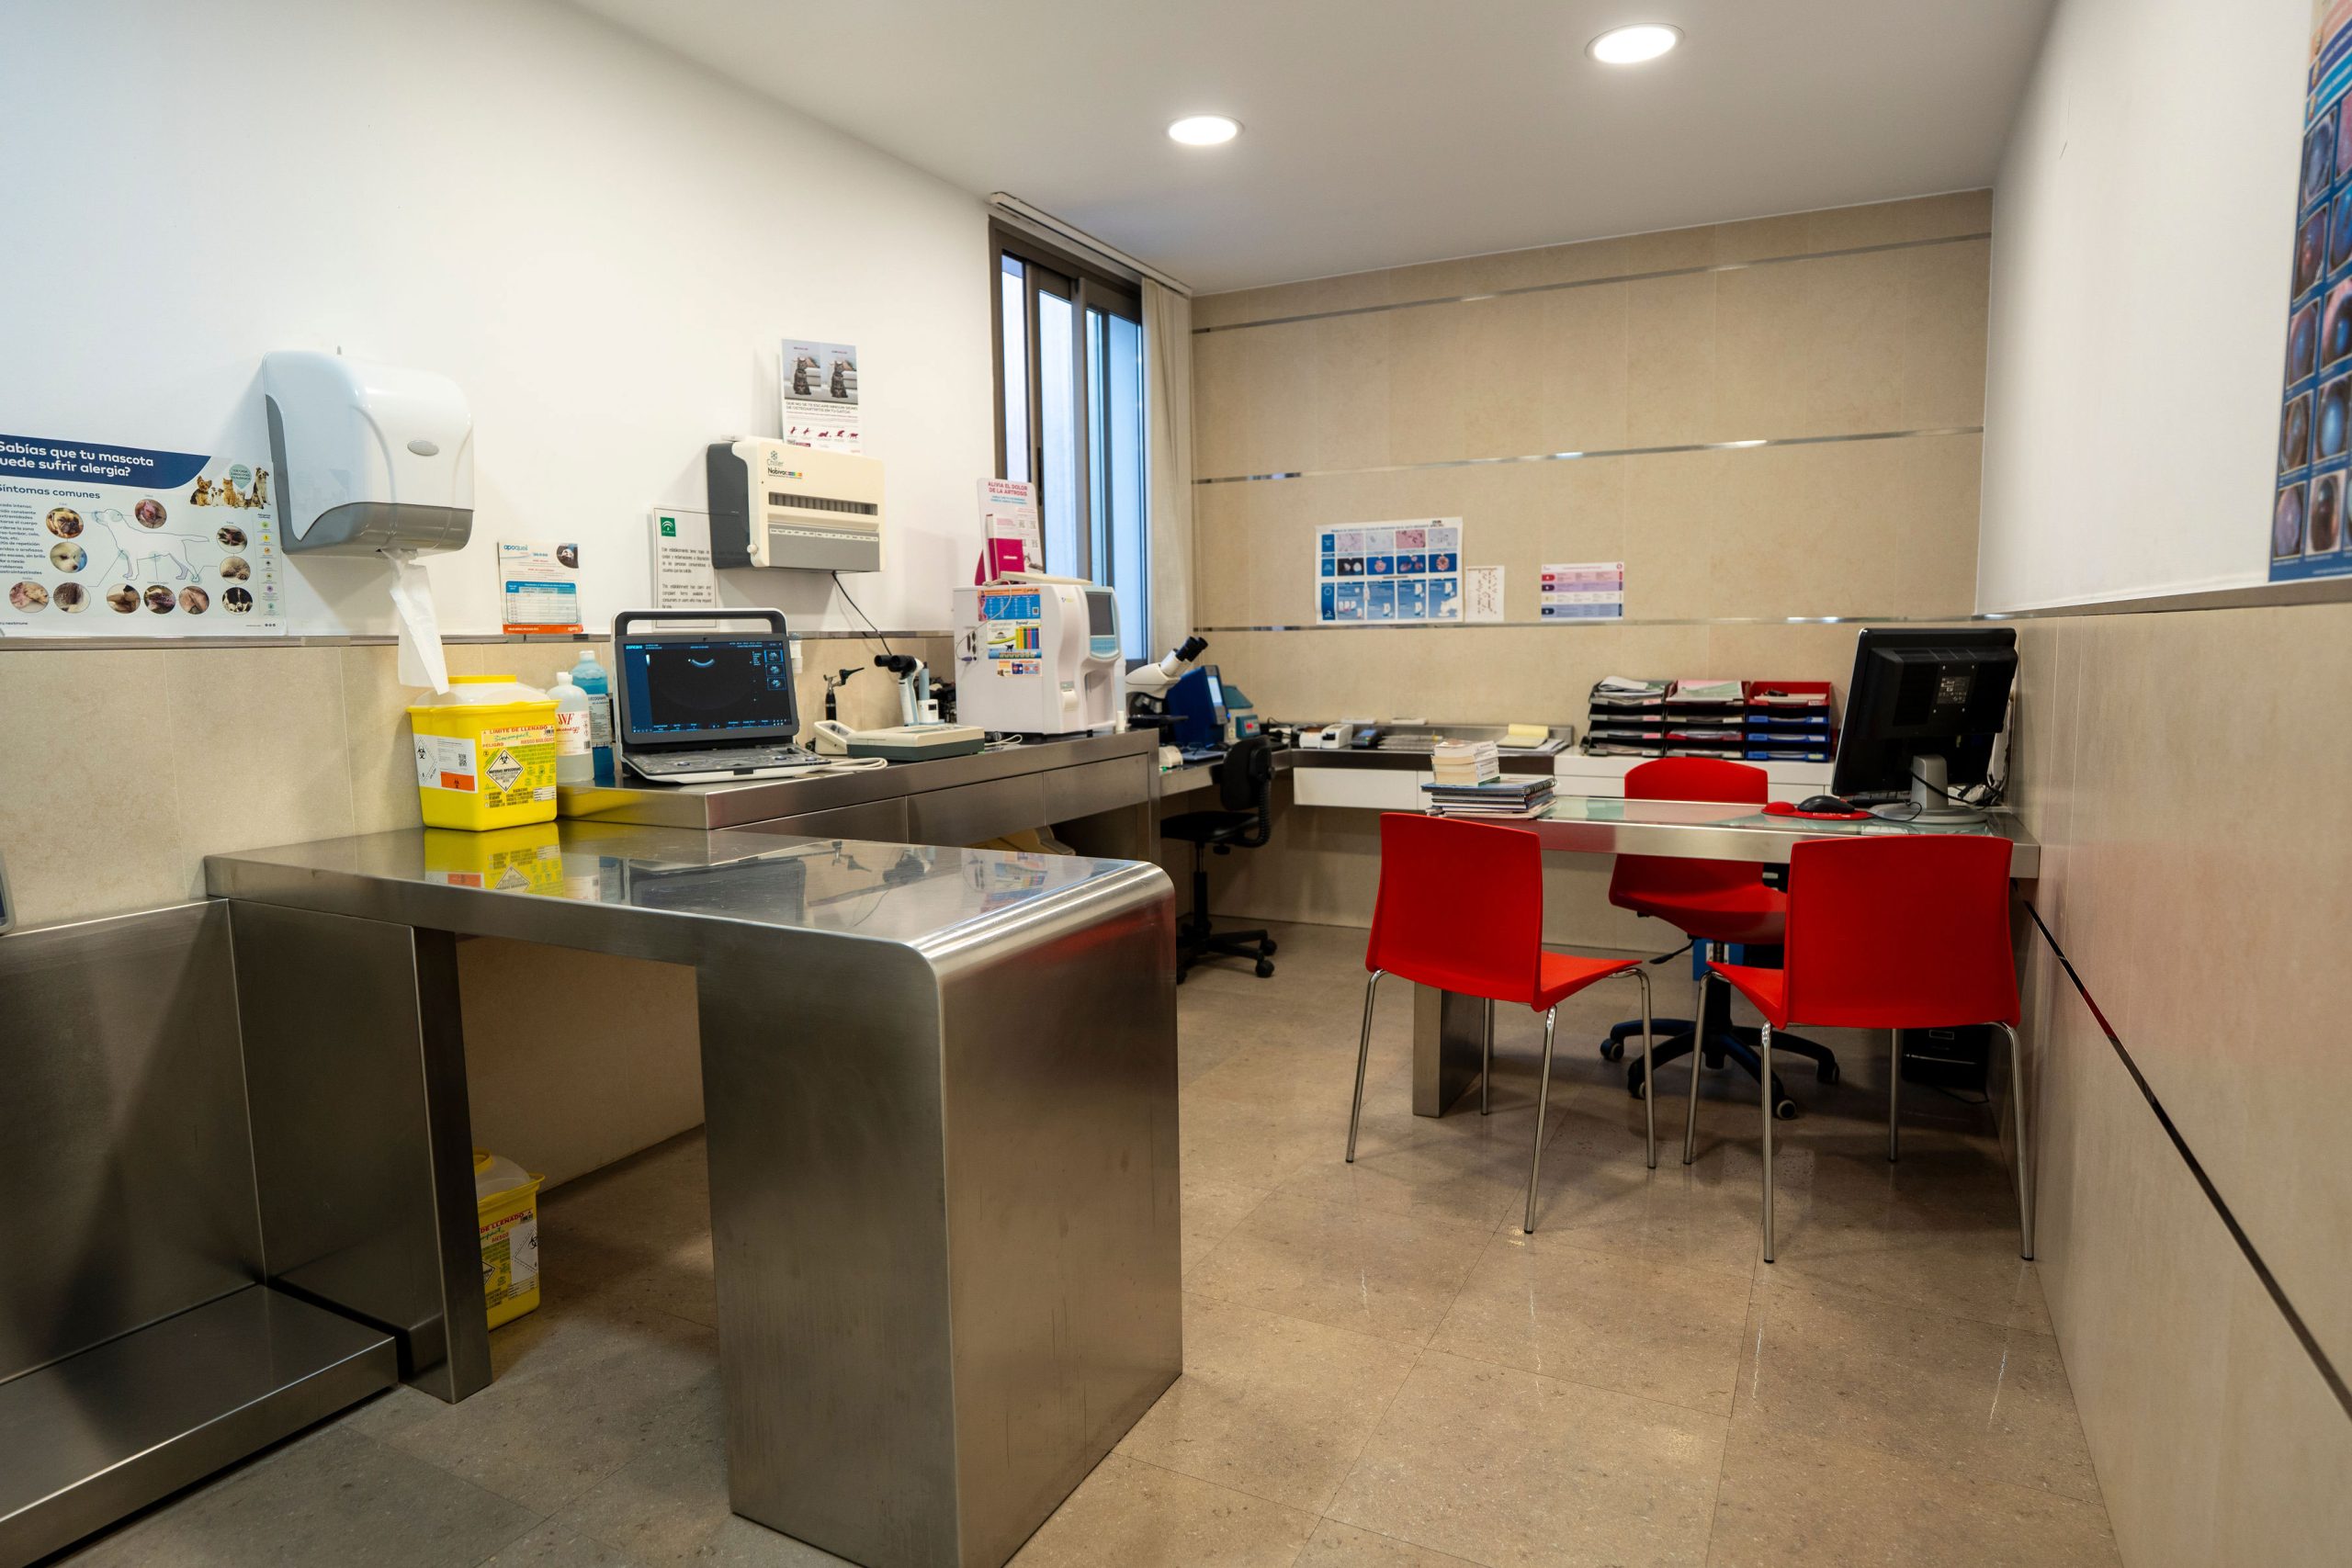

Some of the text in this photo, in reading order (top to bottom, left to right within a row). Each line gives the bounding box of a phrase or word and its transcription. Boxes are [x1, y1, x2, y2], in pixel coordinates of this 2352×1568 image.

[0, 442, 154, 467] Sabías que tu mascota
[0, 457, 131, 478] uede sufrir alergia?
[0, 484, 100, 500] Síntomas comunes
[480, 1213, 524, 1234] DE LLENADO
